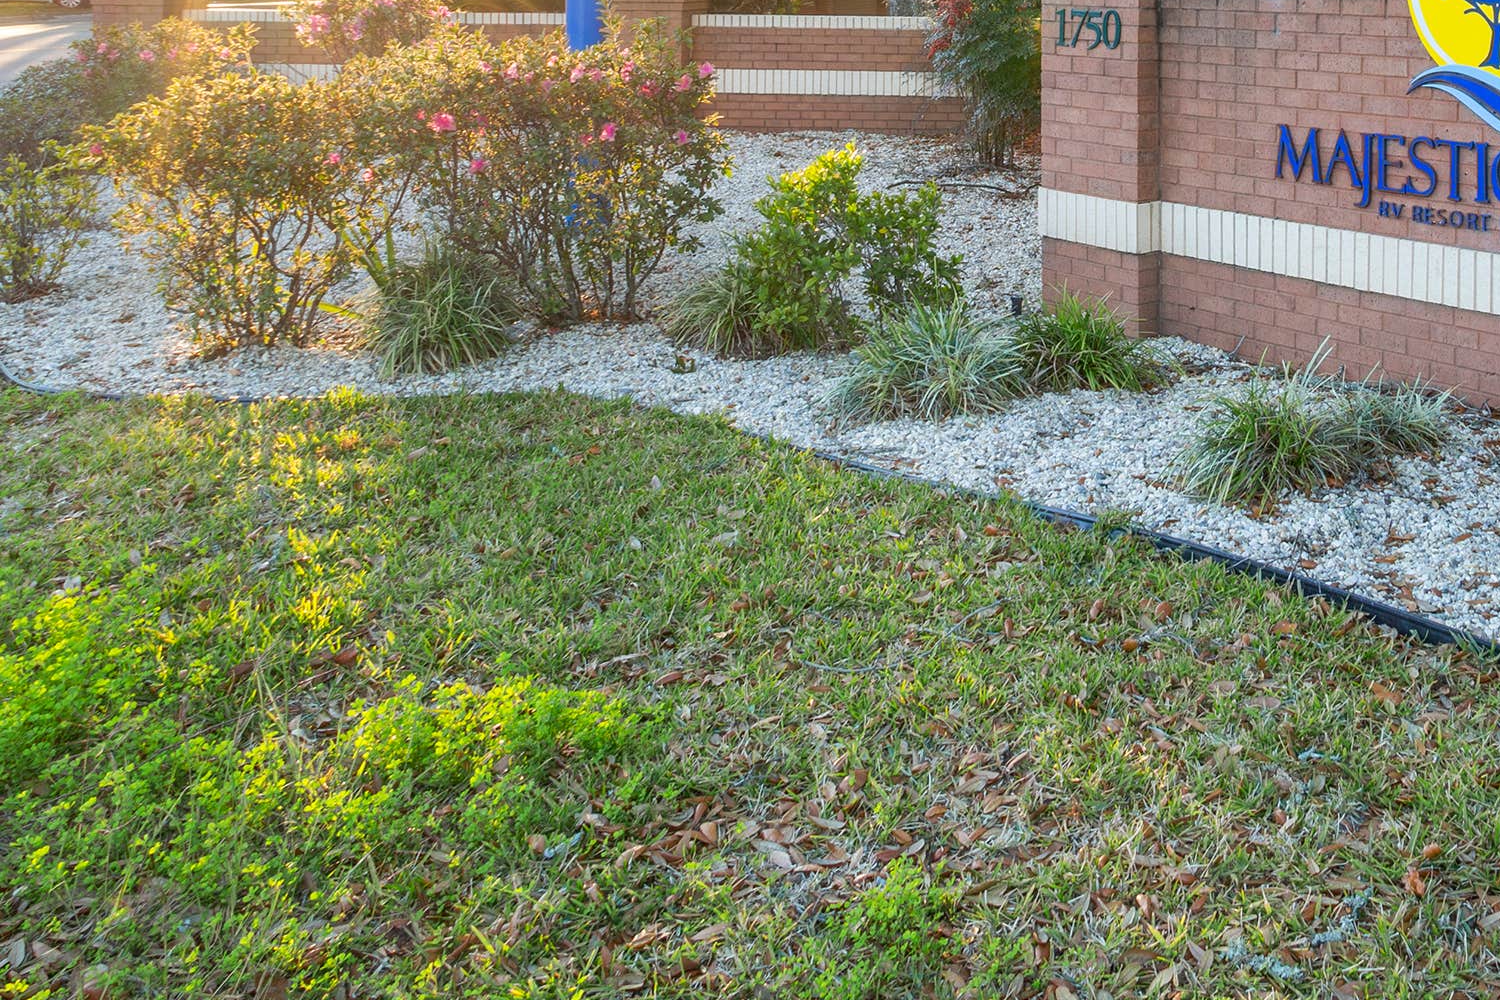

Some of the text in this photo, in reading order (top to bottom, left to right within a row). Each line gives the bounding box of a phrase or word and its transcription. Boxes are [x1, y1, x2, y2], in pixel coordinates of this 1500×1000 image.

[1055, 8, 1121, 50] 1750
[1378, 200, 1405, 219] RV
[1412, 205, 1492, 233] RESORT
